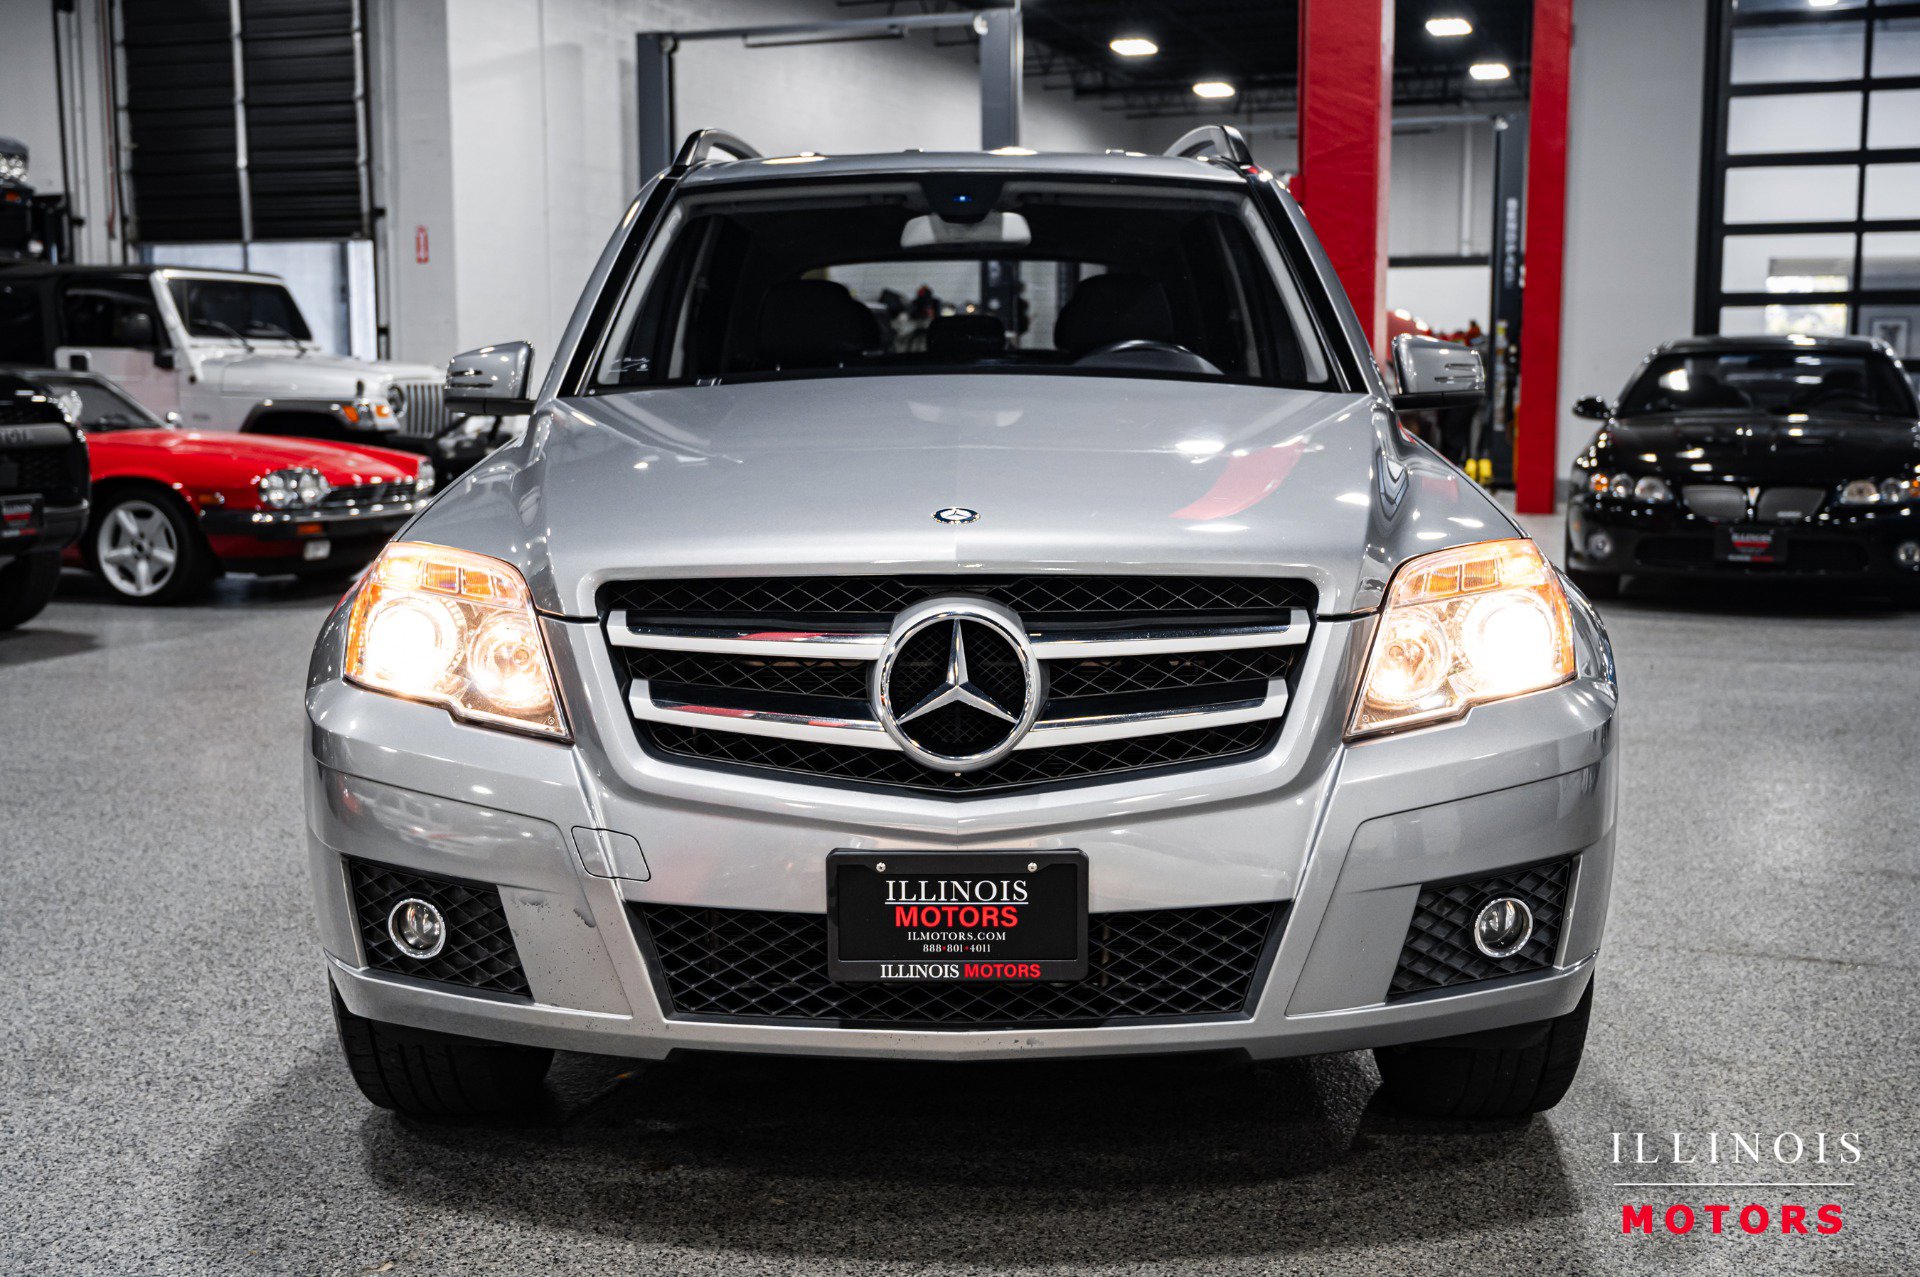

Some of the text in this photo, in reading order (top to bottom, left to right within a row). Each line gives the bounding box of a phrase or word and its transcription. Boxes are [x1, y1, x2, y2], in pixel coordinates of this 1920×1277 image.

[885, 880, 1029, 902] ILLINOIS
[895, 905, 1019, 928] MOTORS
[907, 931, 1006, 941] ILMOTORS.COM
[880, 963, 1042, 978] ILLINOIS MOTORS
